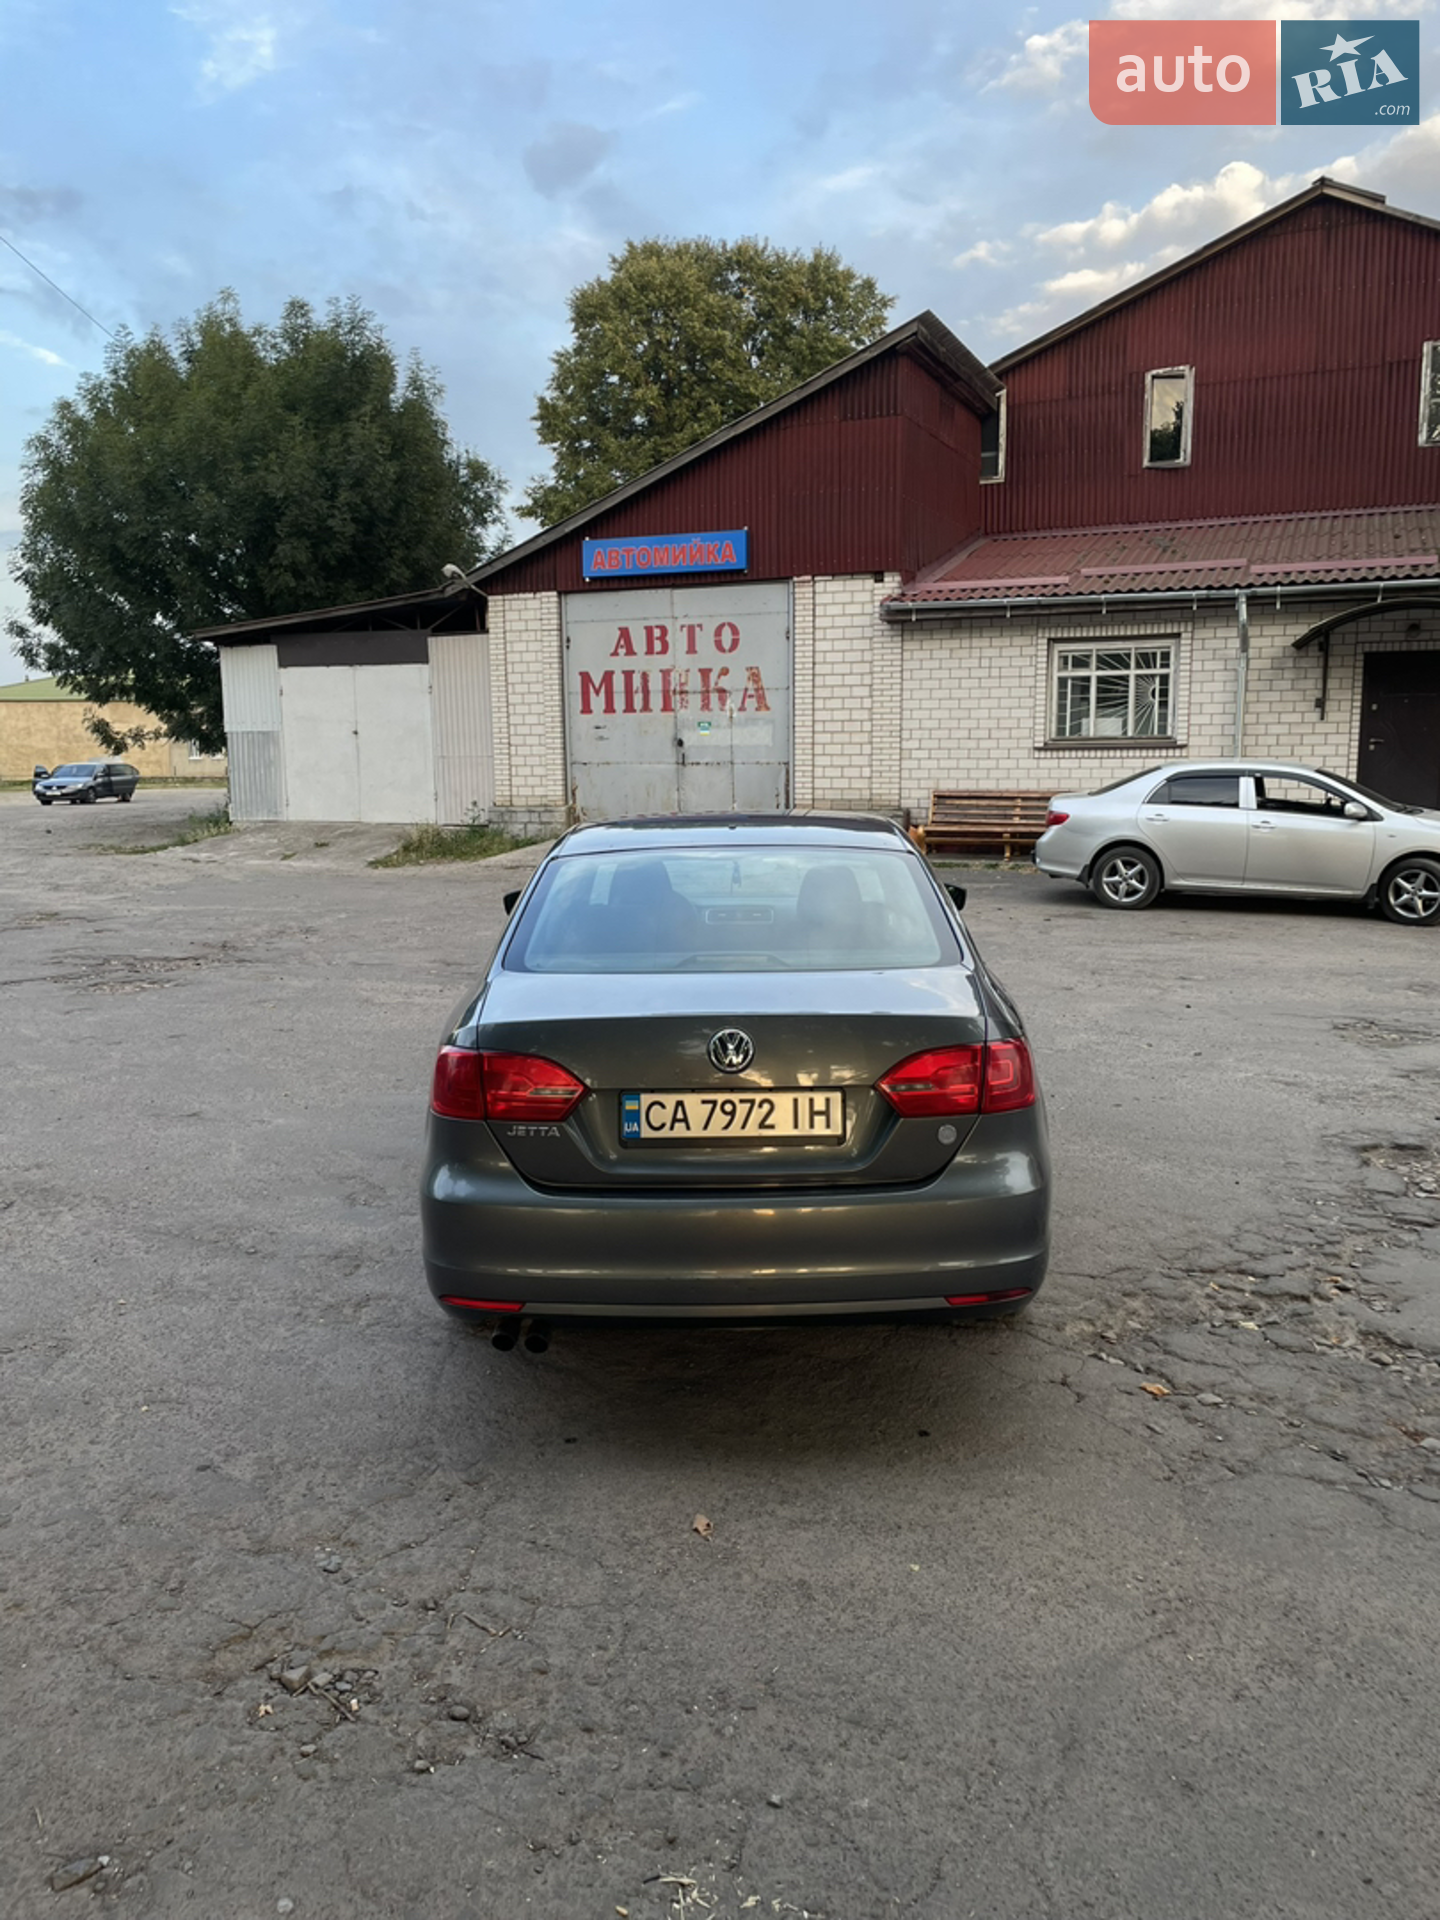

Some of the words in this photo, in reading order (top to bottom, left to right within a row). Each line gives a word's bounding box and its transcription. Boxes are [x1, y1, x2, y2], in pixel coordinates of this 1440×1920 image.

[591, 538, 738, 571] АВТОМИЙКА
[609, 621, 741, 657] АВТО
[507, 1125, 561, 1137] JETTA
[625, 1122, 639, 1132] UA
[645, 1100, 691, 1131] CA
[701, 1098, 776, 1130] 7972
